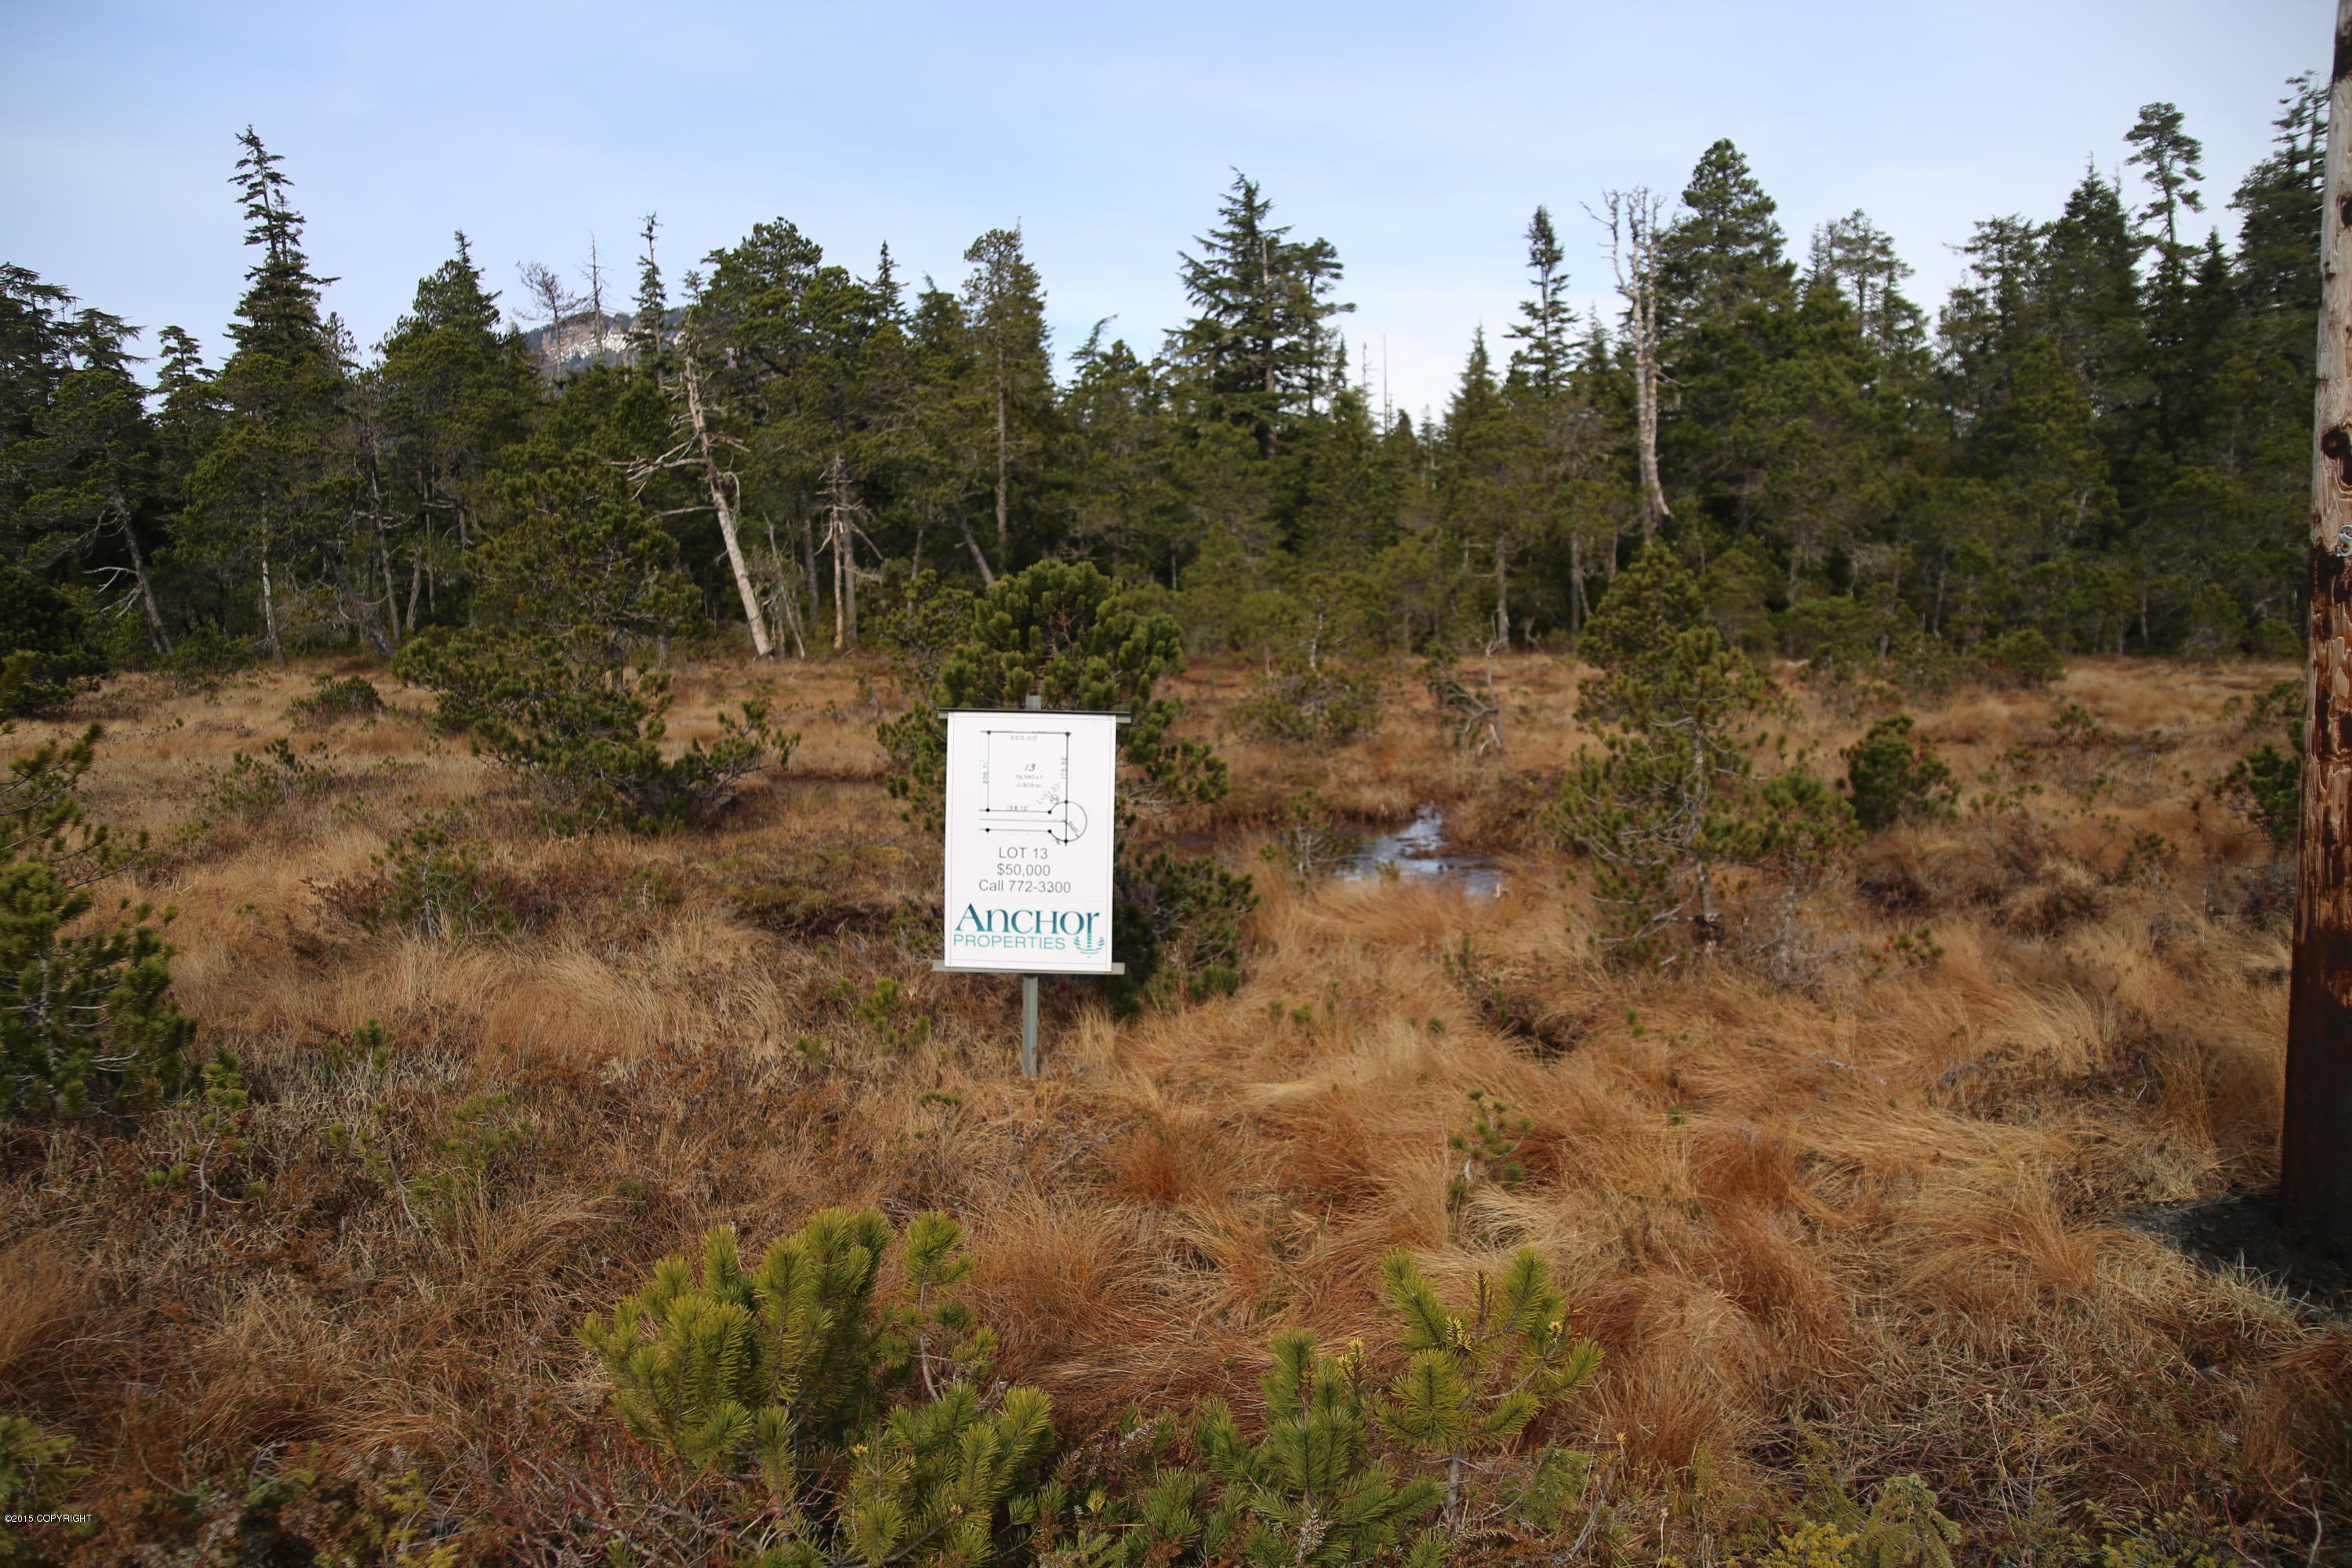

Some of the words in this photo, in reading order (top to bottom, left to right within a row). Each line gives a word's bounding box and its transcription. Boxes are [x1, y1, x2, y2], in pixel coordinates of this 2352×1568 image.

[1025, 763, 1036, 771] 13
[999, 847, 1027, 859] LOT
[1033, 848, 1048, 860] 13
[996, 862, 1051, 877] $50,000
[978, 879, 1004, 892] Call
[1009, 880, 1072, 894] 772-3300
[953, 934, 1066, 950] PROPERTIES
